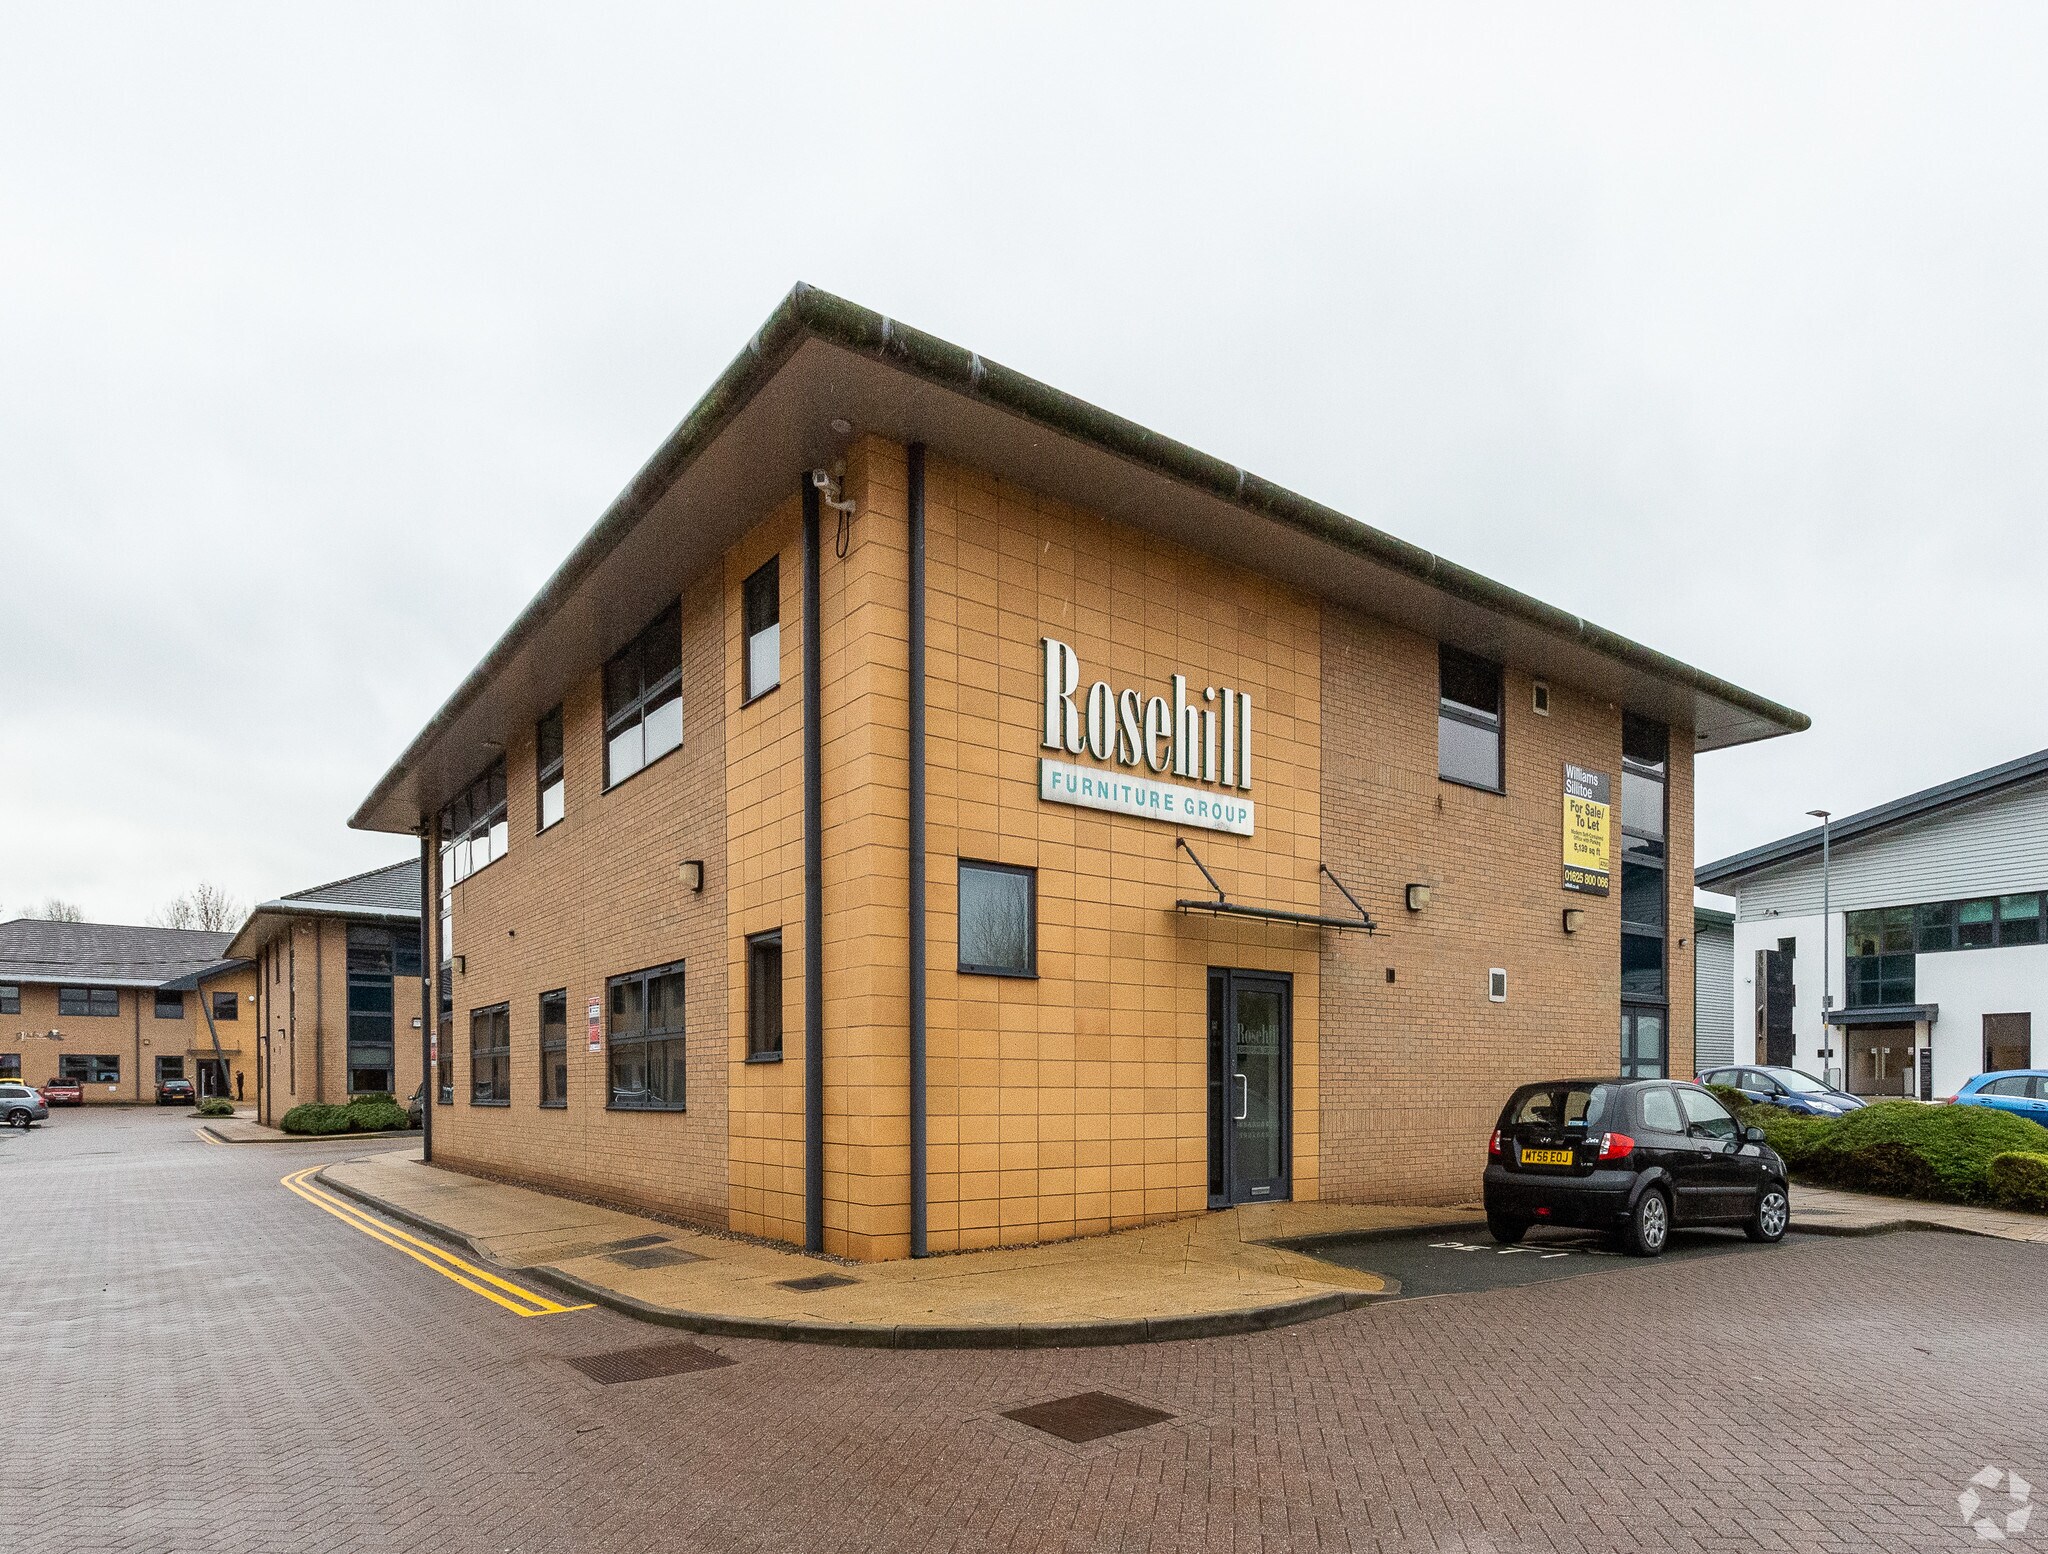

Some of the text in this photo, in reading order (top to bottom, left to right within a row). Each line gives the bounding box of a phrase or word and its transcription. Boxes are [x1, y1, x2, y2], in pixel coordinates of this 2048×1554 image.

[1041, 636, 1253, 791] Rosehill
[1566, 764, 1599, 786] Williams
[1051, 771, 1248, 824] FURNITURE GROUP
[1566, 780, 1593, 799] Sillitoe
[1570, 799, 1605, 819] For Sale/
[1575, 815, 1600, 832] To Let
[1589, 847, 1595, 856] sq
[1596, 847, 1601, 856] ft
[1565, 870, 1583, 884] 01625
[1525, 1150, 1548, 1162] MT56
